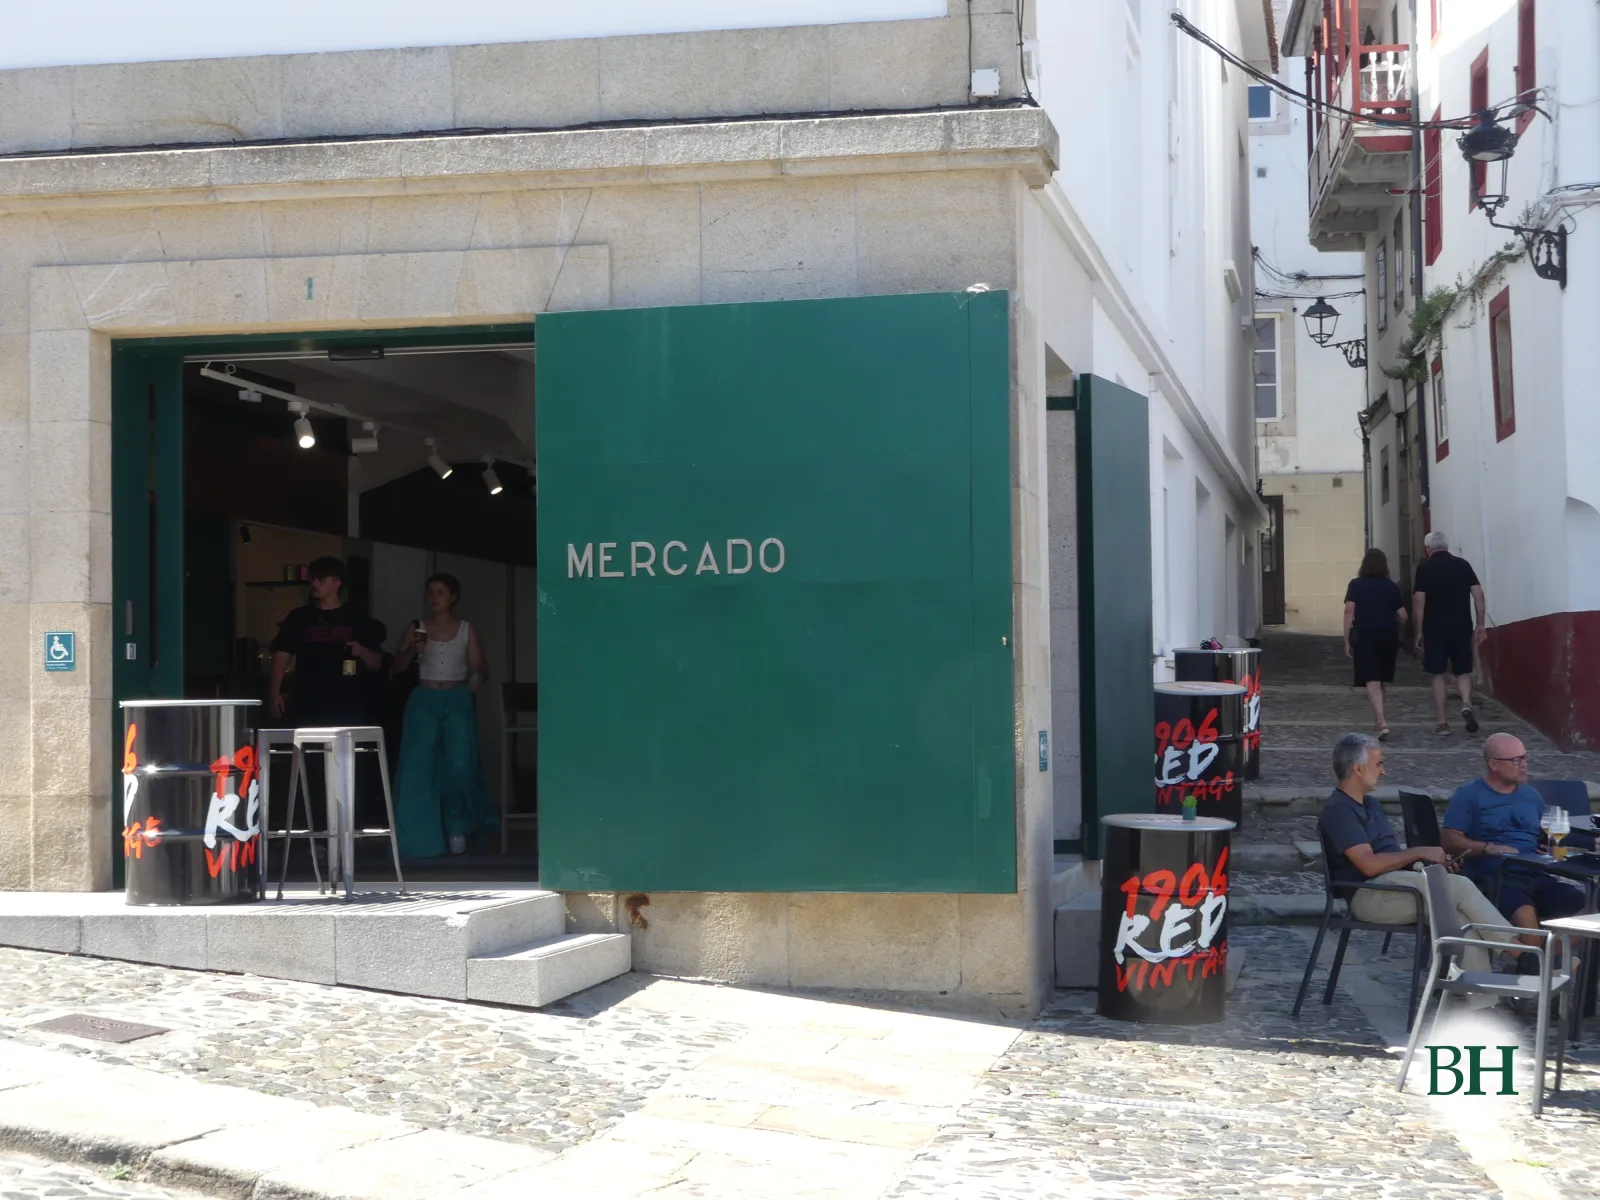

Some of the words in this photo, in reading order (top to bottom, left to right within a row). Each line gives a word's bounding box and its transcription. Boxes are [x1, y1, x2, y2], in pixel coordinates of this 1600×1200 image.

[567, 537, 786, 579] MERCADO
[209, 744, 259, 800] 19
[1154, 739, 1220, 788] ED
[1120, 846, 1228, 921] 1906
[1114, 892, 1227, 965] RED
